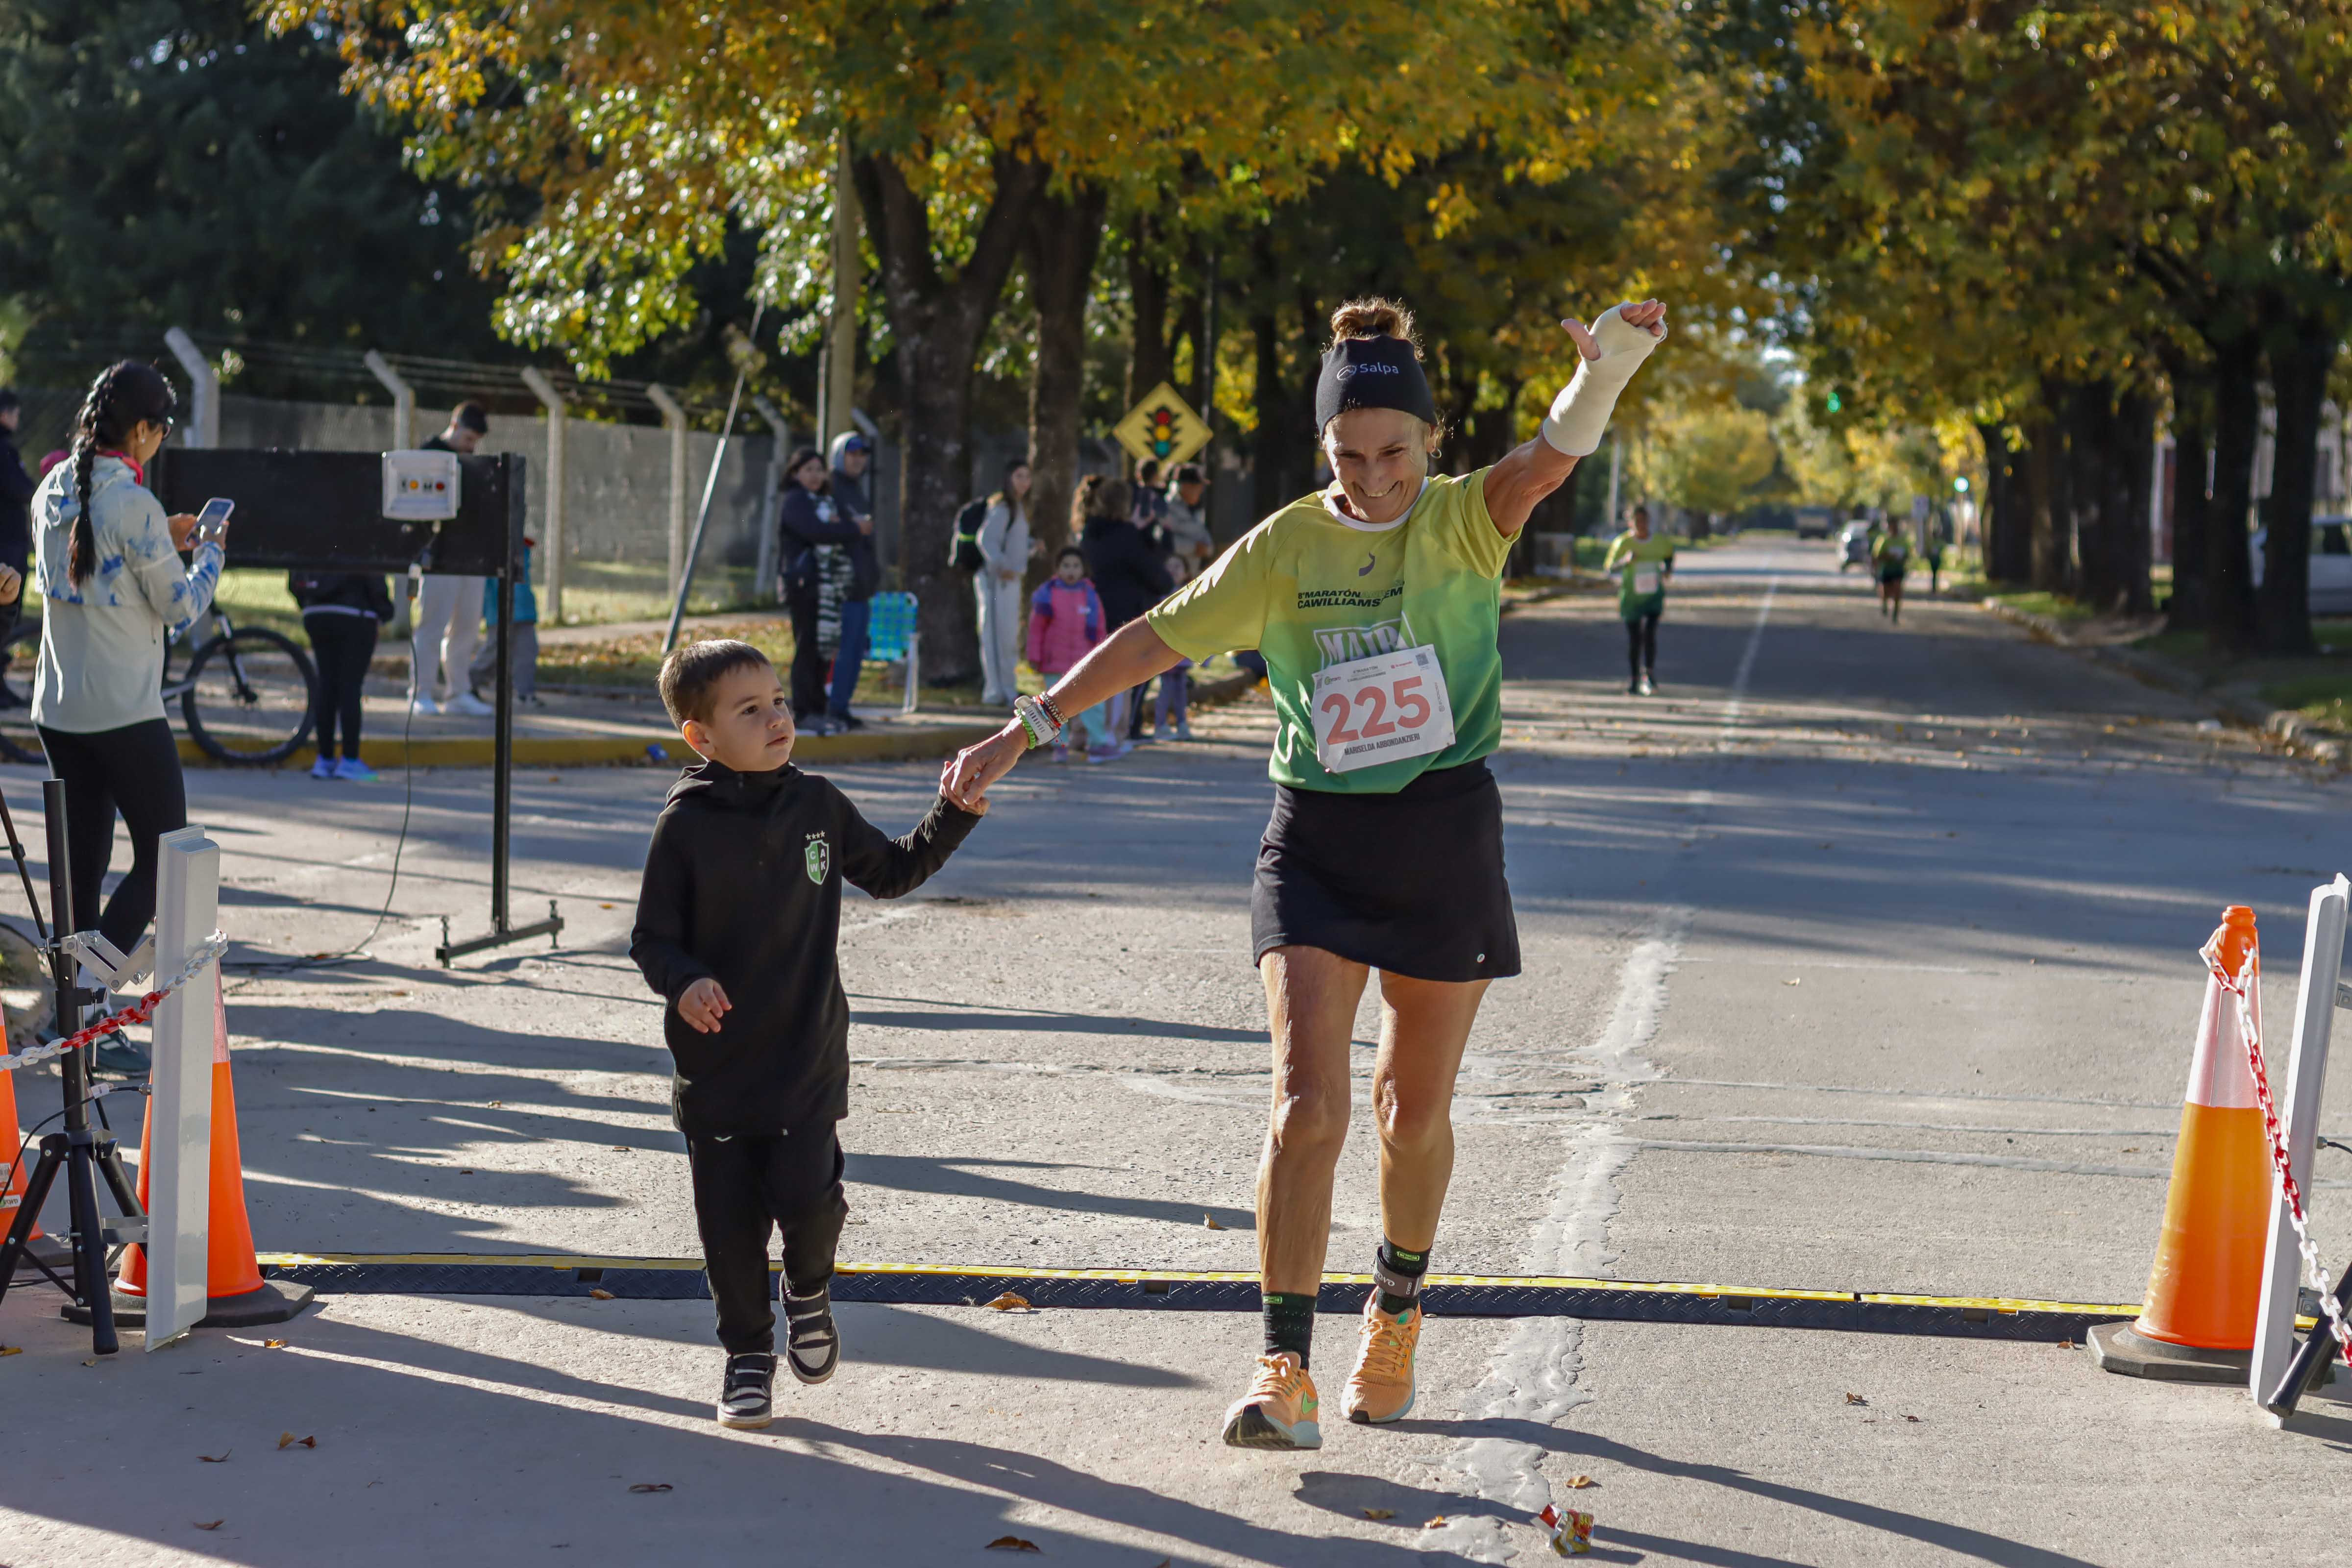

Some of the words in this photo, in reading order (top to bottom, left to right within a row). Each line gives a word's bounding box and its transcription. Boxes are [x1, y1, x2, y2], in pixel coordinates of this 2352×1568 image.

[1360, 362, 1399, 374] Salpa
[1321, 675, 1431, 745] 225
[1344, 743, 1376, 756] MARISELDA
[1376, 733, 1421, 749] ABBONDANZIERI
